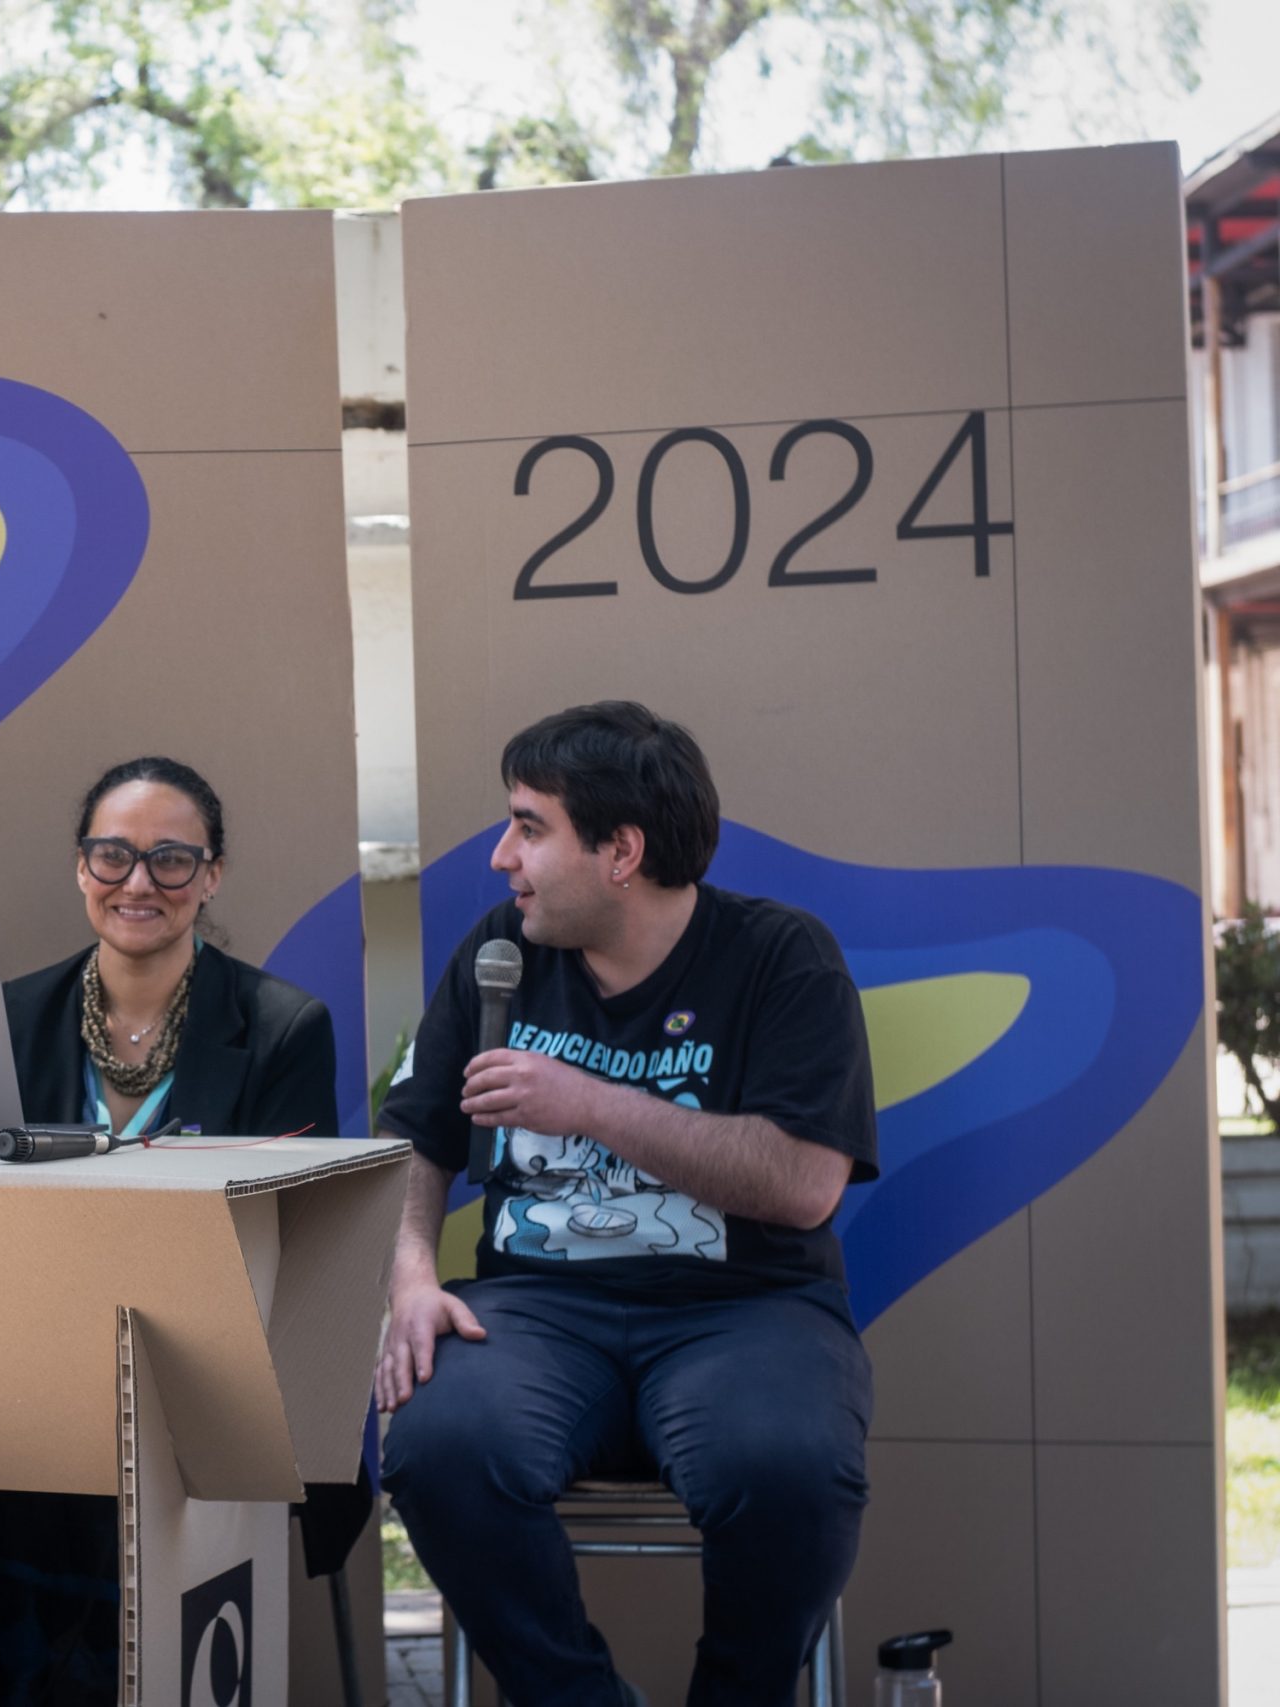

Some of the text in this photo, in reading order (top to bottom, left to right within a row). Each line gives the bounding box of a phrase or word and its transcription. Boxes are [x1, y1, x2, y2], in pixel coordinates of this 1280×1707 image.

[513, 410, 1014, 601] 2024
[508, 1021, 714, 1080] REDUCIENDO DAÑO
